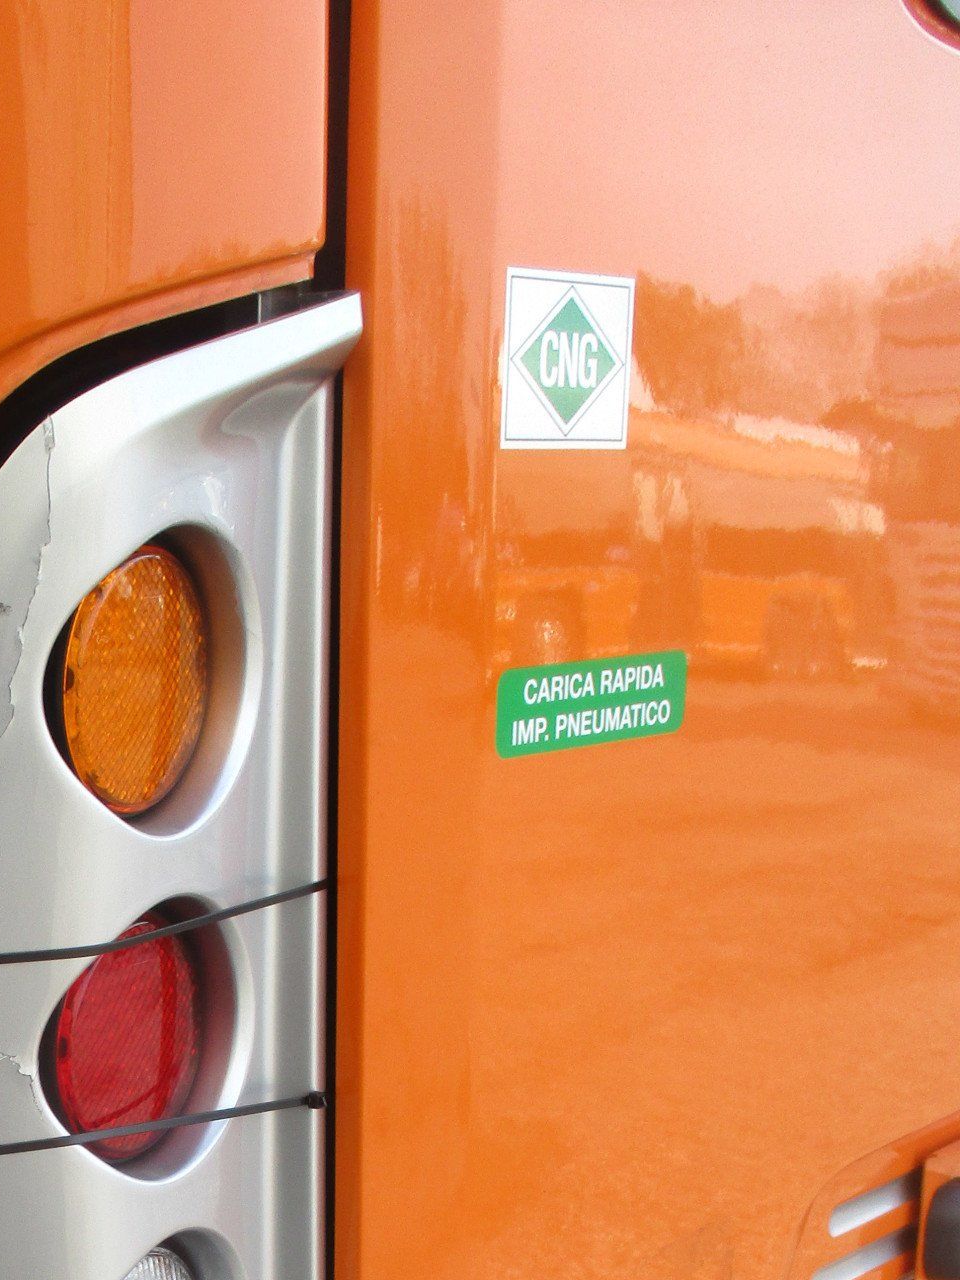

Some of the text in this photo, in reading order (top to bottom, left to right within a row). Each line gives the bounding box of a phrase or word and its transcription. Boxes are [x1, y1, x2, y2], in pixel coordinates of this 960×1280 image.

[539, 329, 599, 389] CNG
[523, 663, 664, 706] CARICA RAPIDA
[511, 699, 671, 746] IMP. PNEUMATICO
